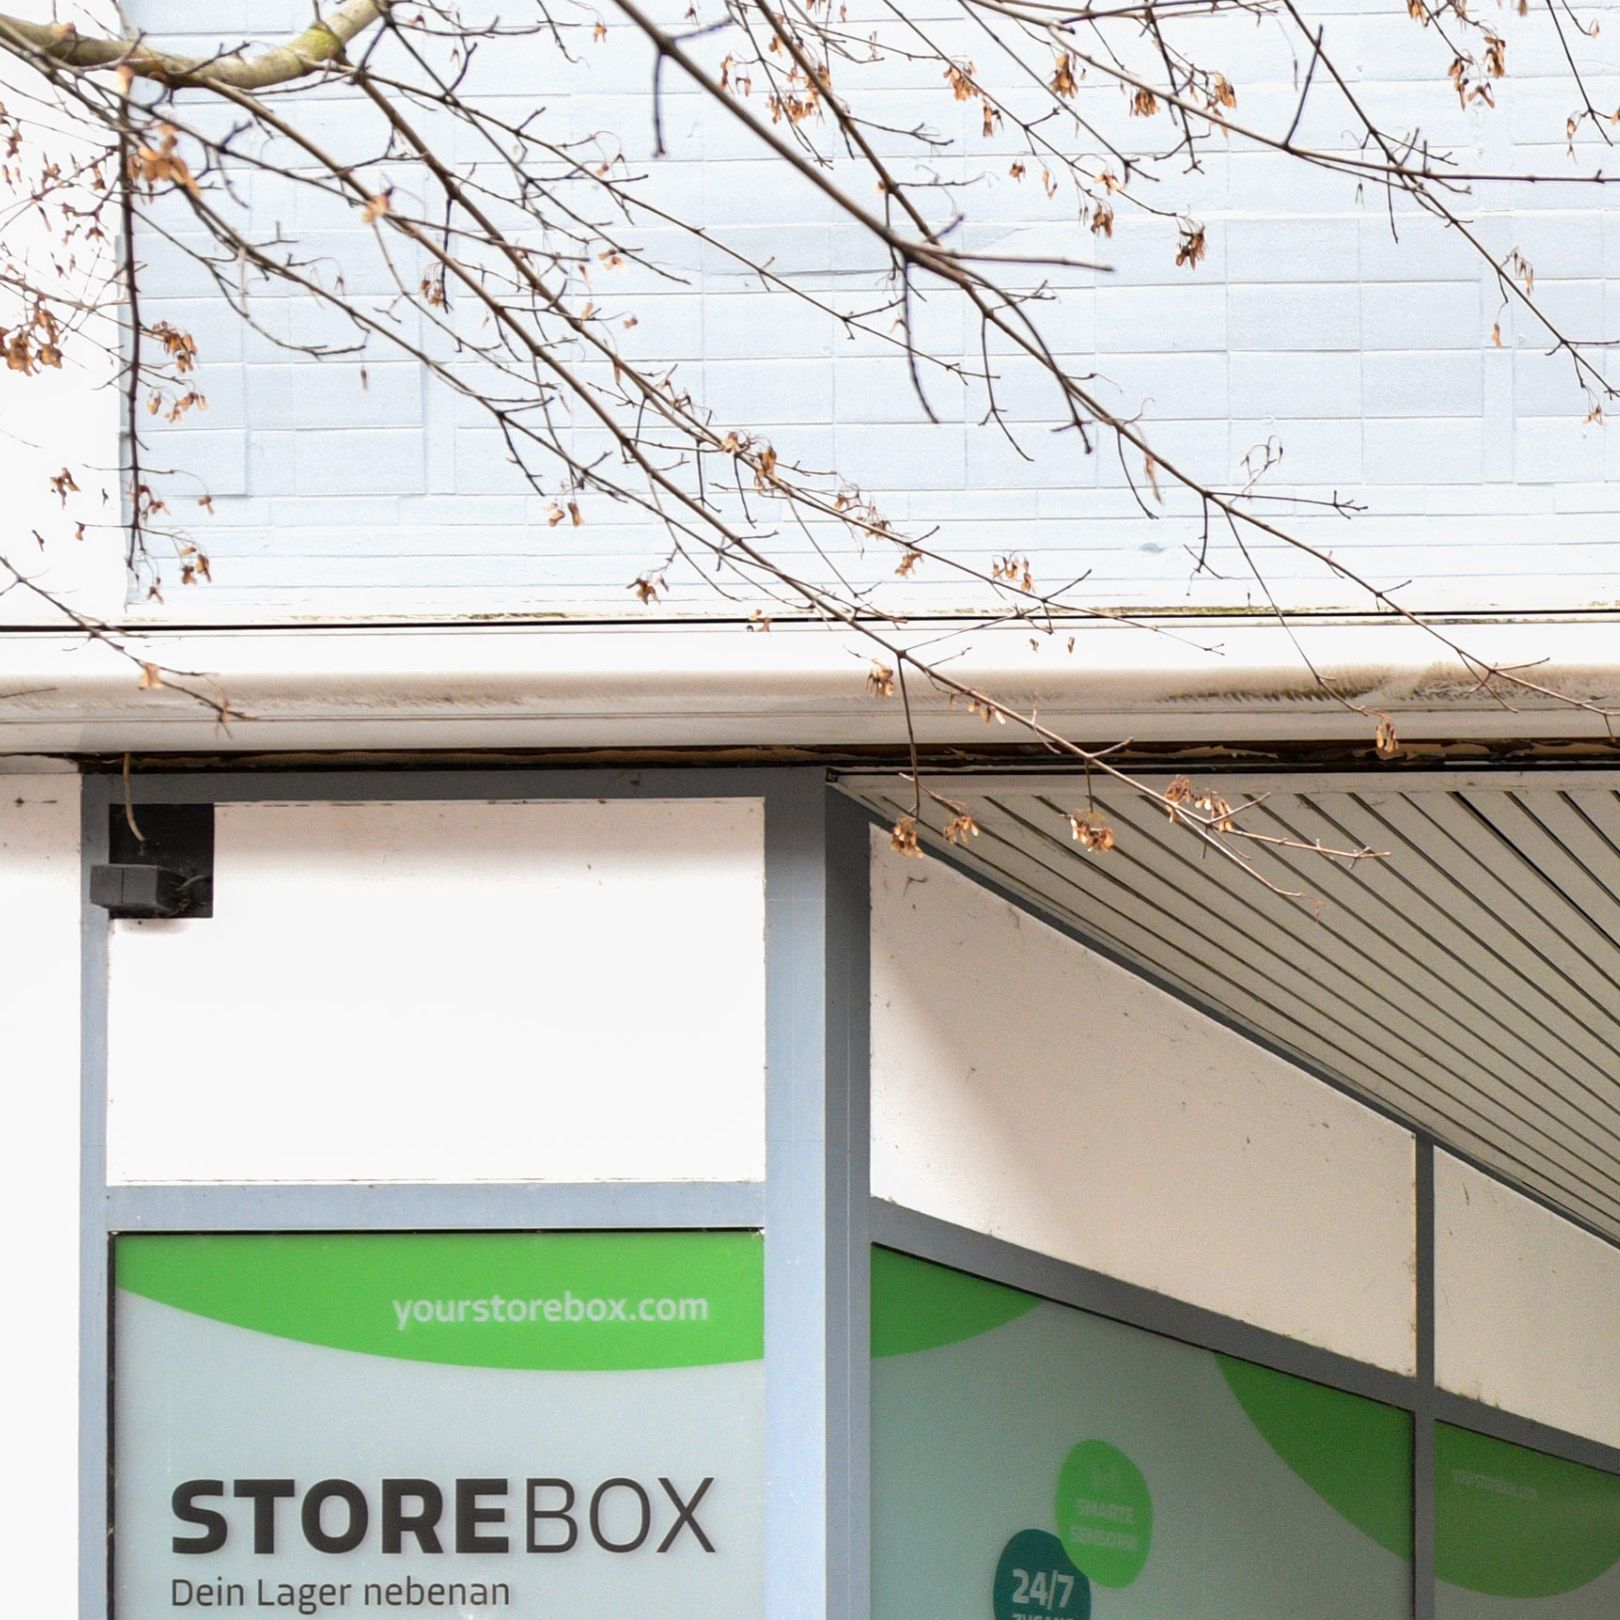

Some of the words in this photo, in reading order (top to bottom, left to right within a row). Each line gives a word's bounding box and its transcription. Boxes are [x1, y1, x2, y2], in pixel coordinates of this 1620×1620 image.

[392, 1292, 709, 1331] yourstorebox.com
[170, 1477, 717, 1555] STOREBOX
[170, 1578, 245, 1608] Dein
[257, 1578, 352, 1615] Lager
[364, 1576, 511, 1608] nebenan
[1012, 1568, 1075, 1610] 24/7
